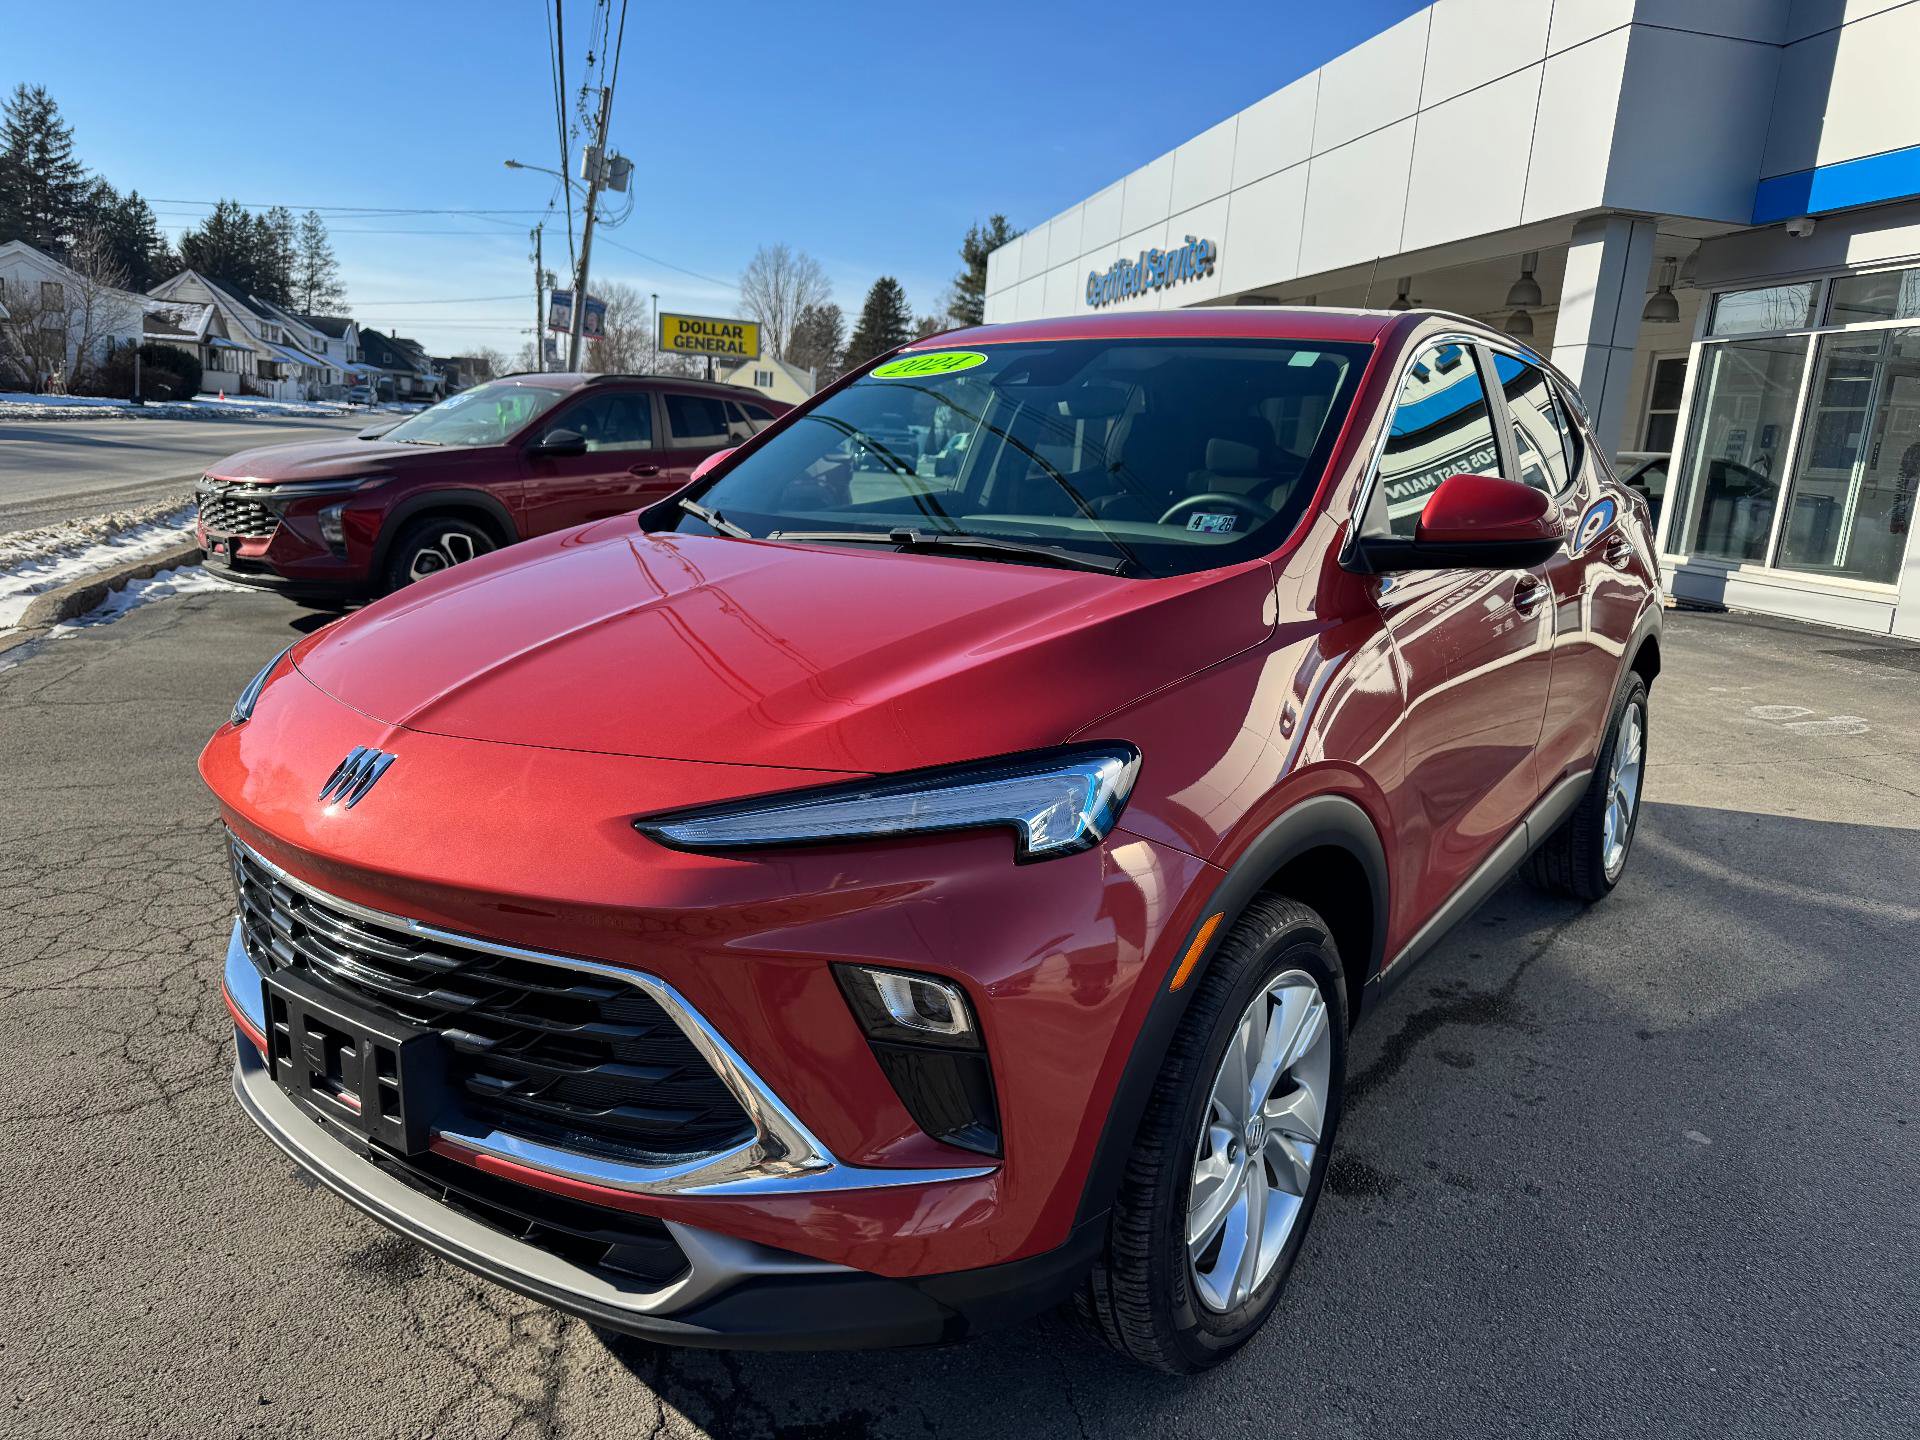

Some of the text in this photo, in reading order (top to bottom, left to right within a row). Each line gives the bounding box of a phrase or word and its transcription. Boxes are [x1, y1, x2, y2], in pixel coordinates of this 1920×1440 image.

[1086, 235, 1216, 308] Certified Service
[679, 320, 744, 339] DOLLAR
[674, 335, 747, 354] GENERAL
[883, 355, 974, 375] 2024
[1192, 515, 1204, 530] 4
